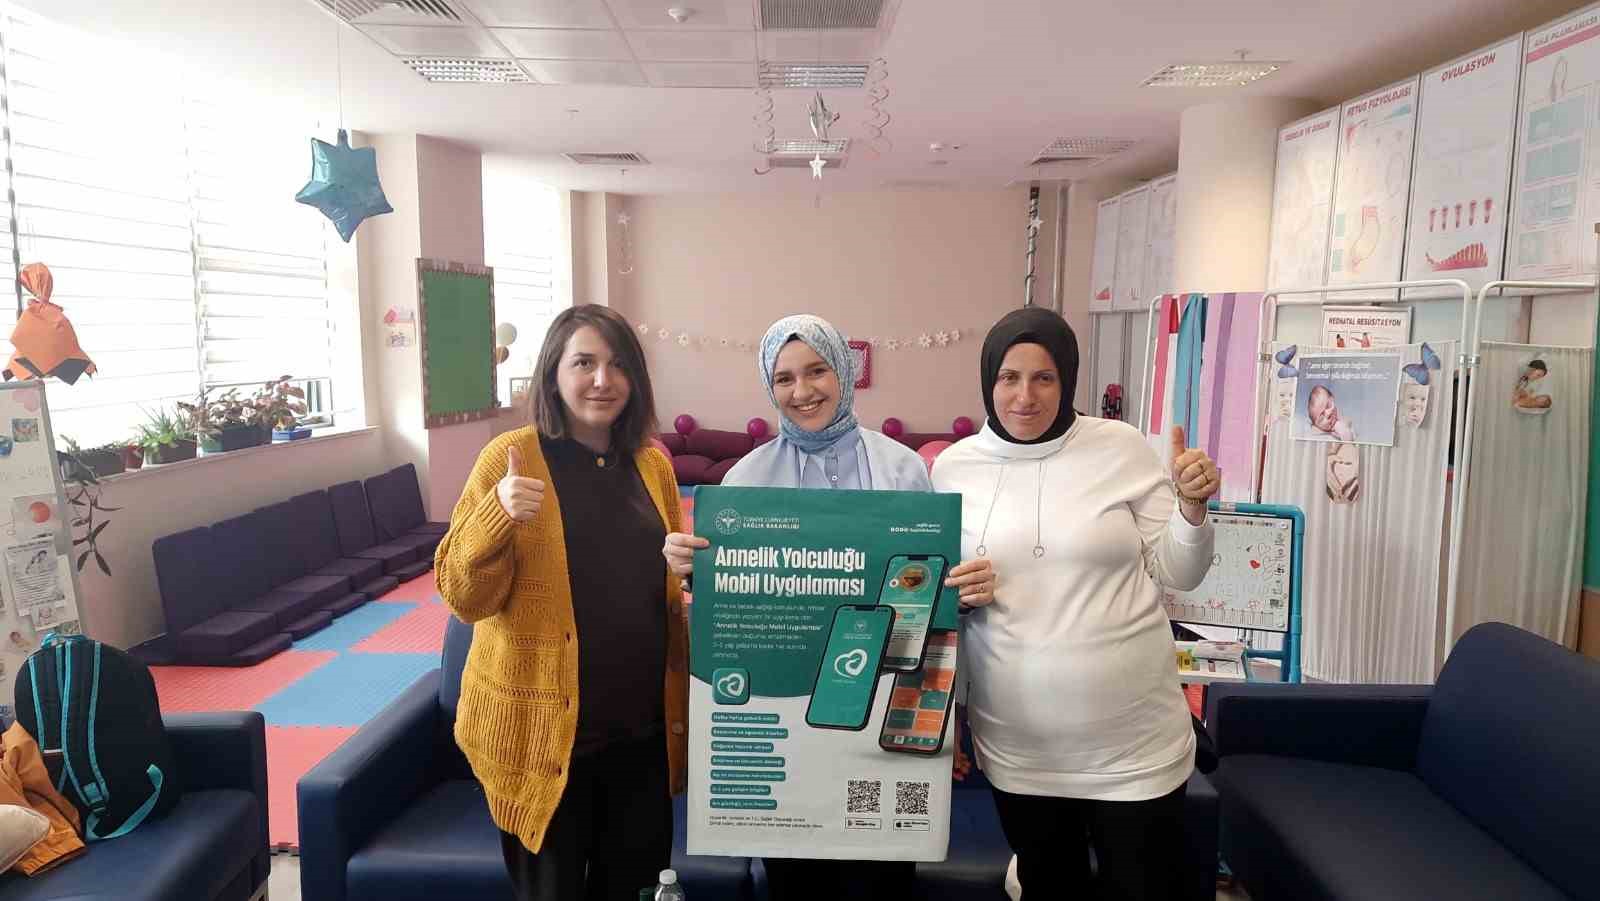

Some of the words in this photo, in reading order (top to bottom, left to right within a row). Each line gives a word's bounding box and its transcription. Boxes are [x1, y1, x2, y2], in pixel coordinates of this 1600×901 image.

[1441, 52, 1496, 82] OVULASYON
[715, 546, 778, 569] Annelik
[782, 547, 866, 573] Yolculuğu
[715, 572, 760, 594] Mobil
[763, 573, 865, 598] Uygulaması
